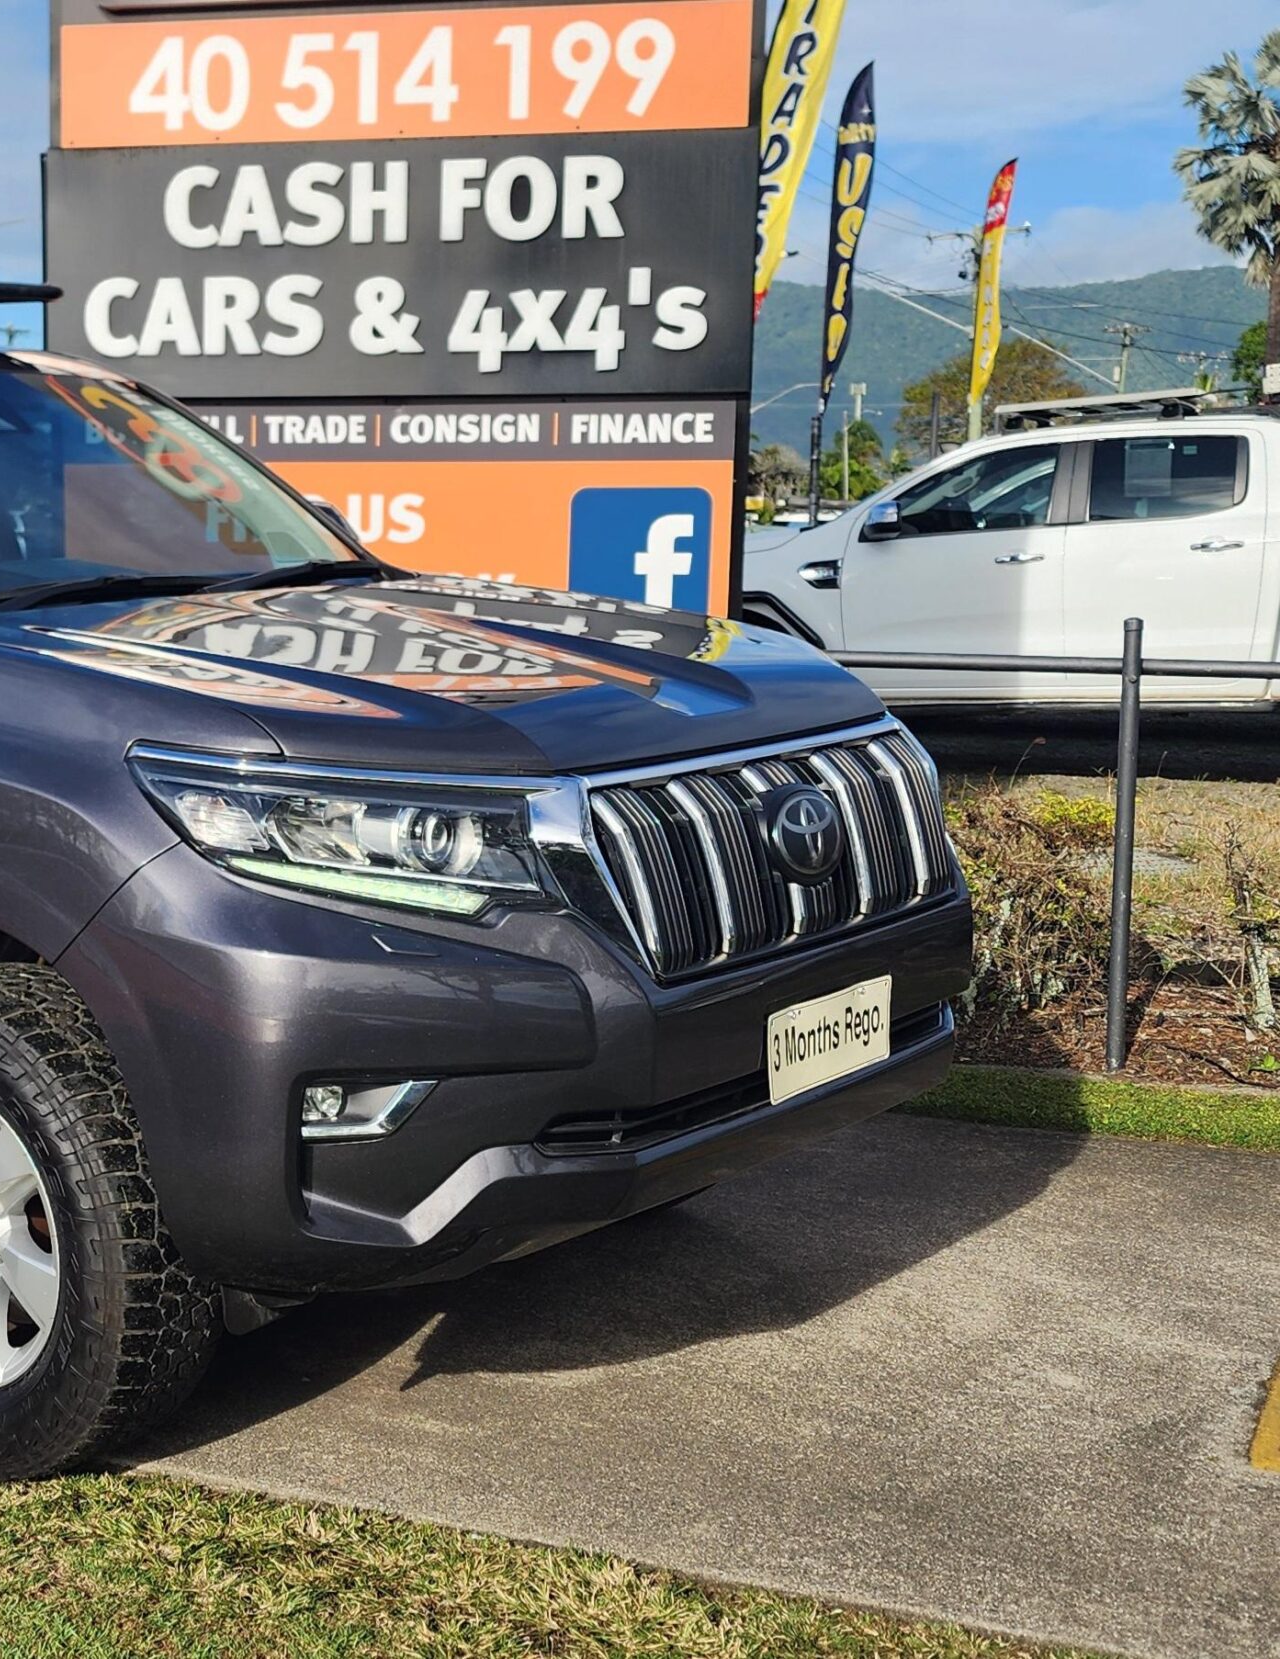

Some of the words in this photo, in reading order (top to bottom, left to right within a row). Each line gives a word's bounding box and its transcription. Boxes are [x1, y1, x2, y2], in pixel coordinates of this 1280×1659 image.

[128, 35, 250, 132] 40
[274, 26, 458, 128] 514
[494, 18, 675, 120] 199
[163, 160, 408, 249] CASH
[439, 155, 625, 242] FOR
[83, 274, 324, 357] CARS
[348, 276, 424, 355] &
[264, 414, 366, 444] TRADE
[389, 413, 540, 444] CONSIGN
[570, 412, 715, 444] FINANCE
[773, 1034, 781, 1072] 3
[785, 1016, 840, 1066] Months
[844, 1004, 884, 1047] Rego.
